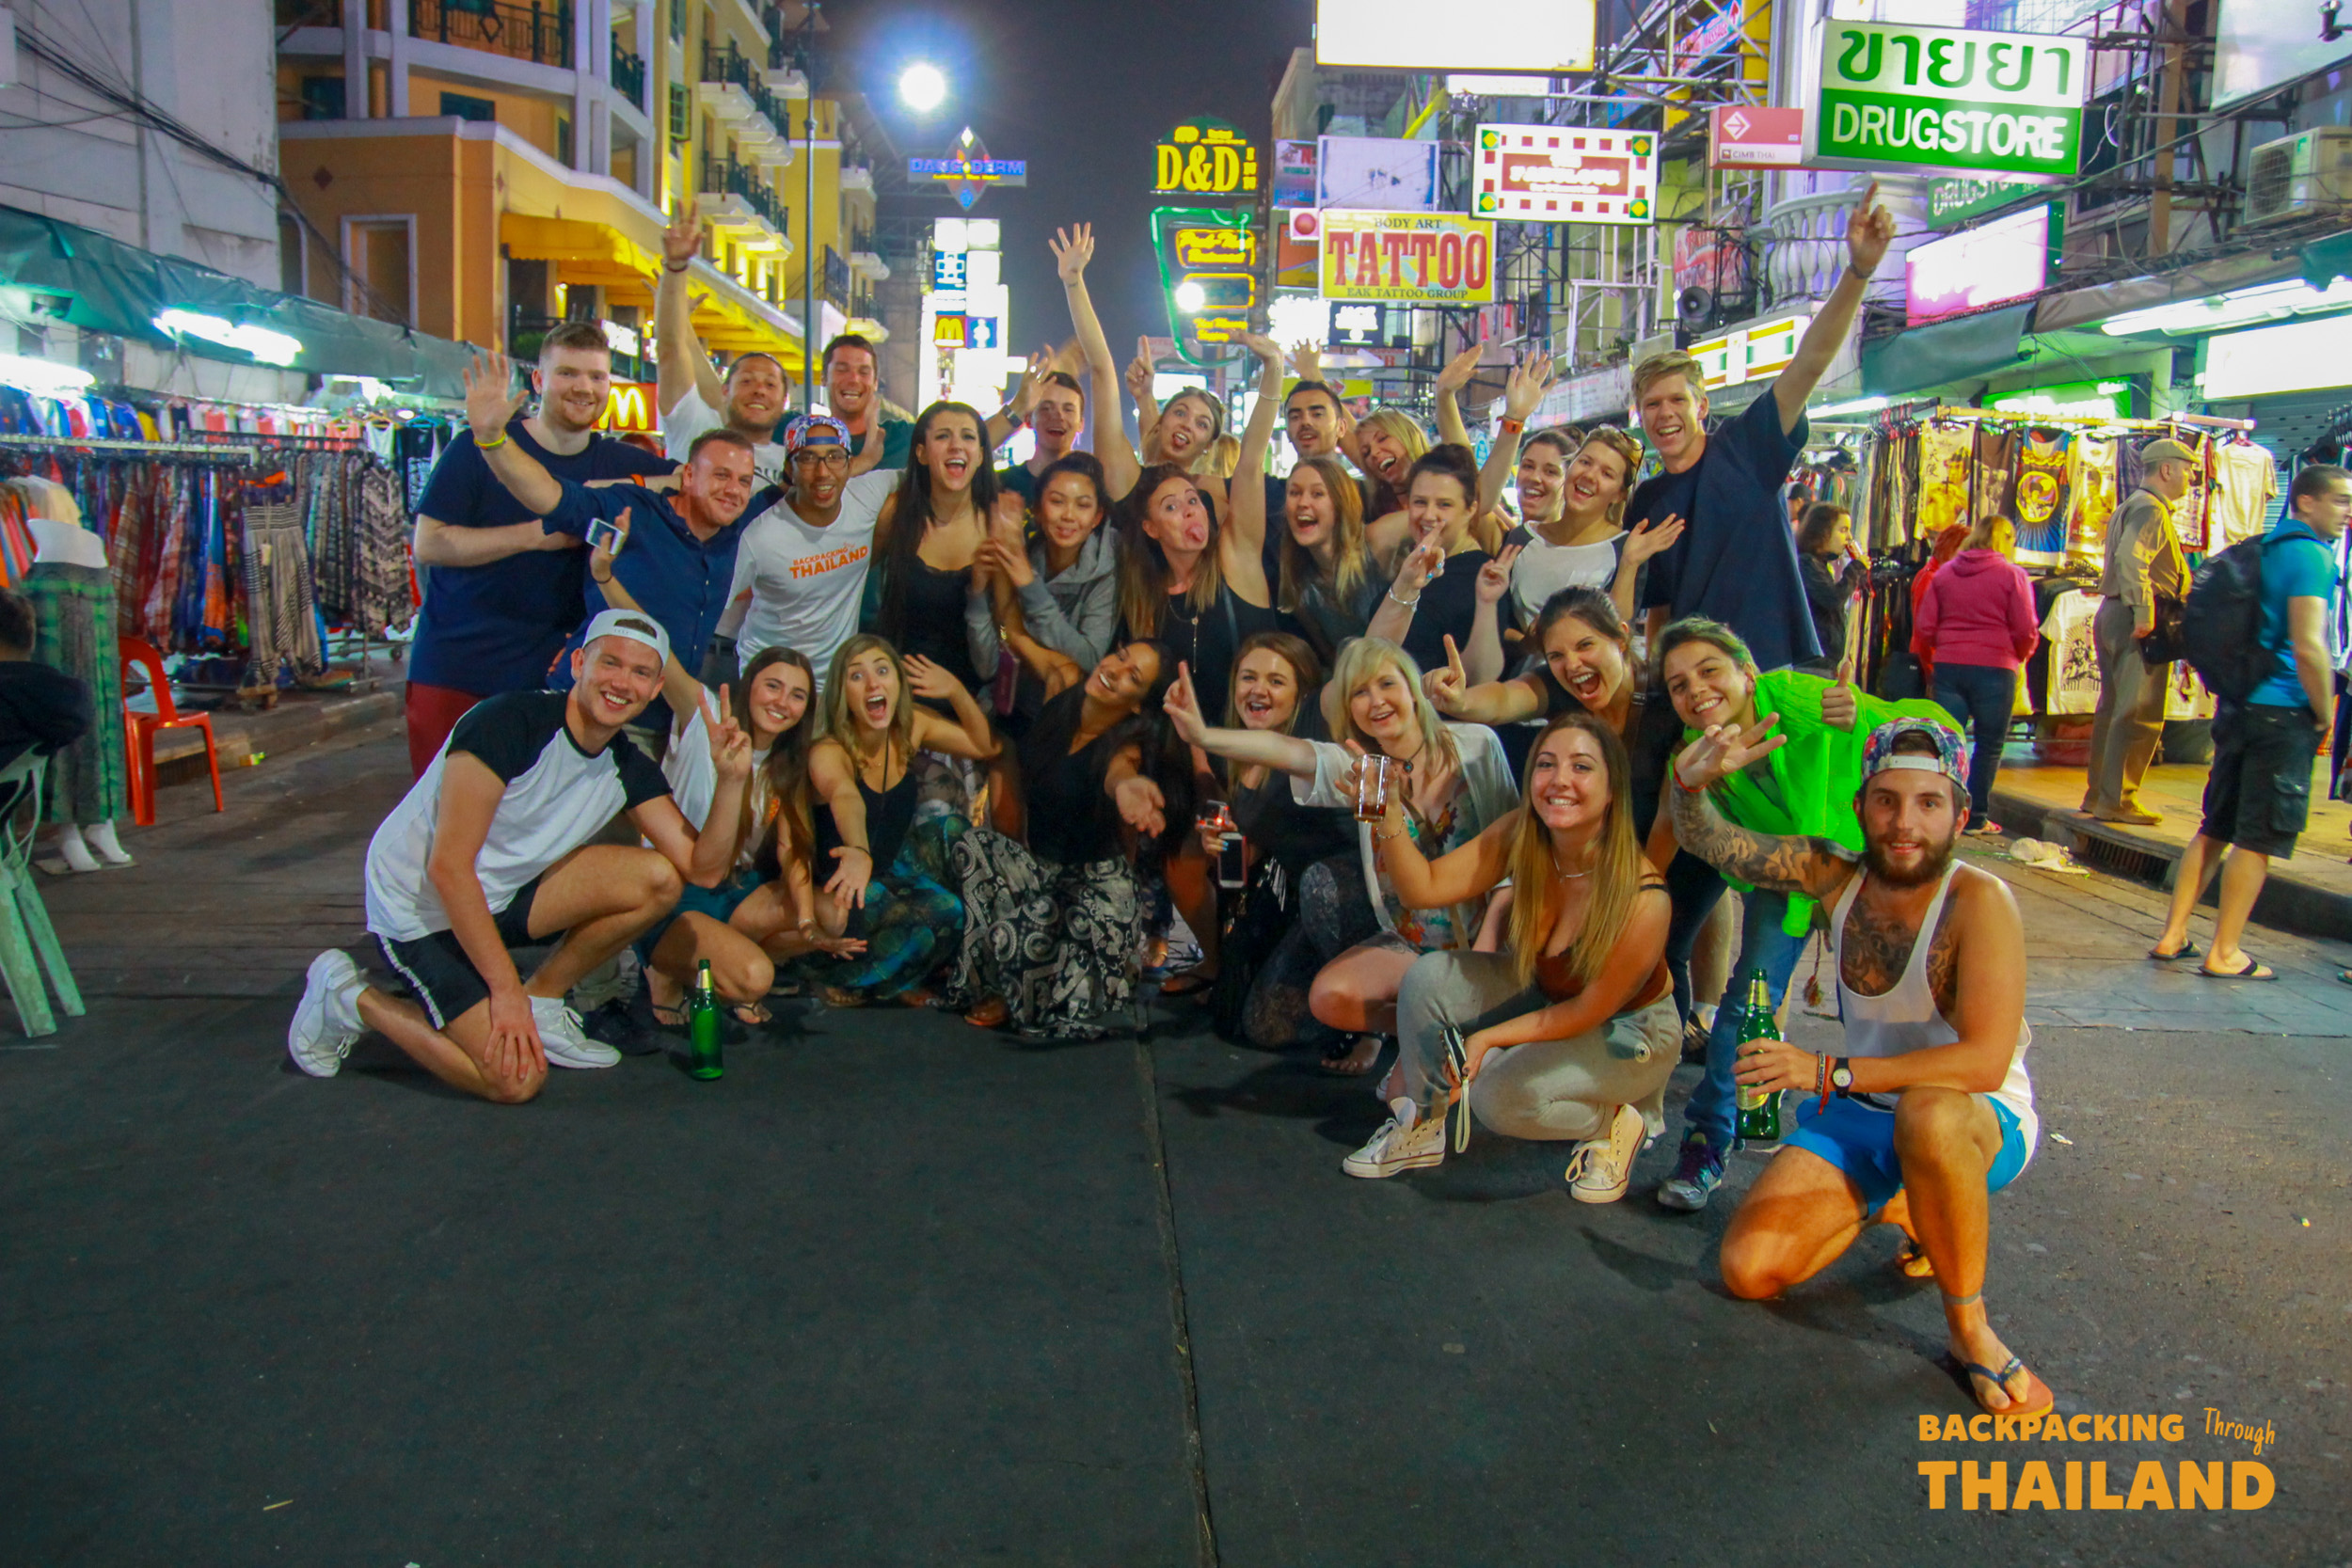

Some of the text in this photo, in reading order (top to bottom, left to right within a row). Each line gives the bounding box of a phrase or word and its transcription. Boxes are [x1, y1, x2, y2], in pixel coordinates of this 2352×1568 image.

[1837, 30, 2070, 95] ขายยา
[1833, 103, 2068, 159] DRUGSTORE
[1155, 144, 1241, 191] D&D
[1375, 218, 1442, 229] BODY ART
[1327, 229, 1487, 290] TATTOO
[1347, 288, 1469, 299] EAK TATTOO GROUP
[788, 546, 869, 579] THAILAND
[793, 546, 849, 566] BACKPACKING
